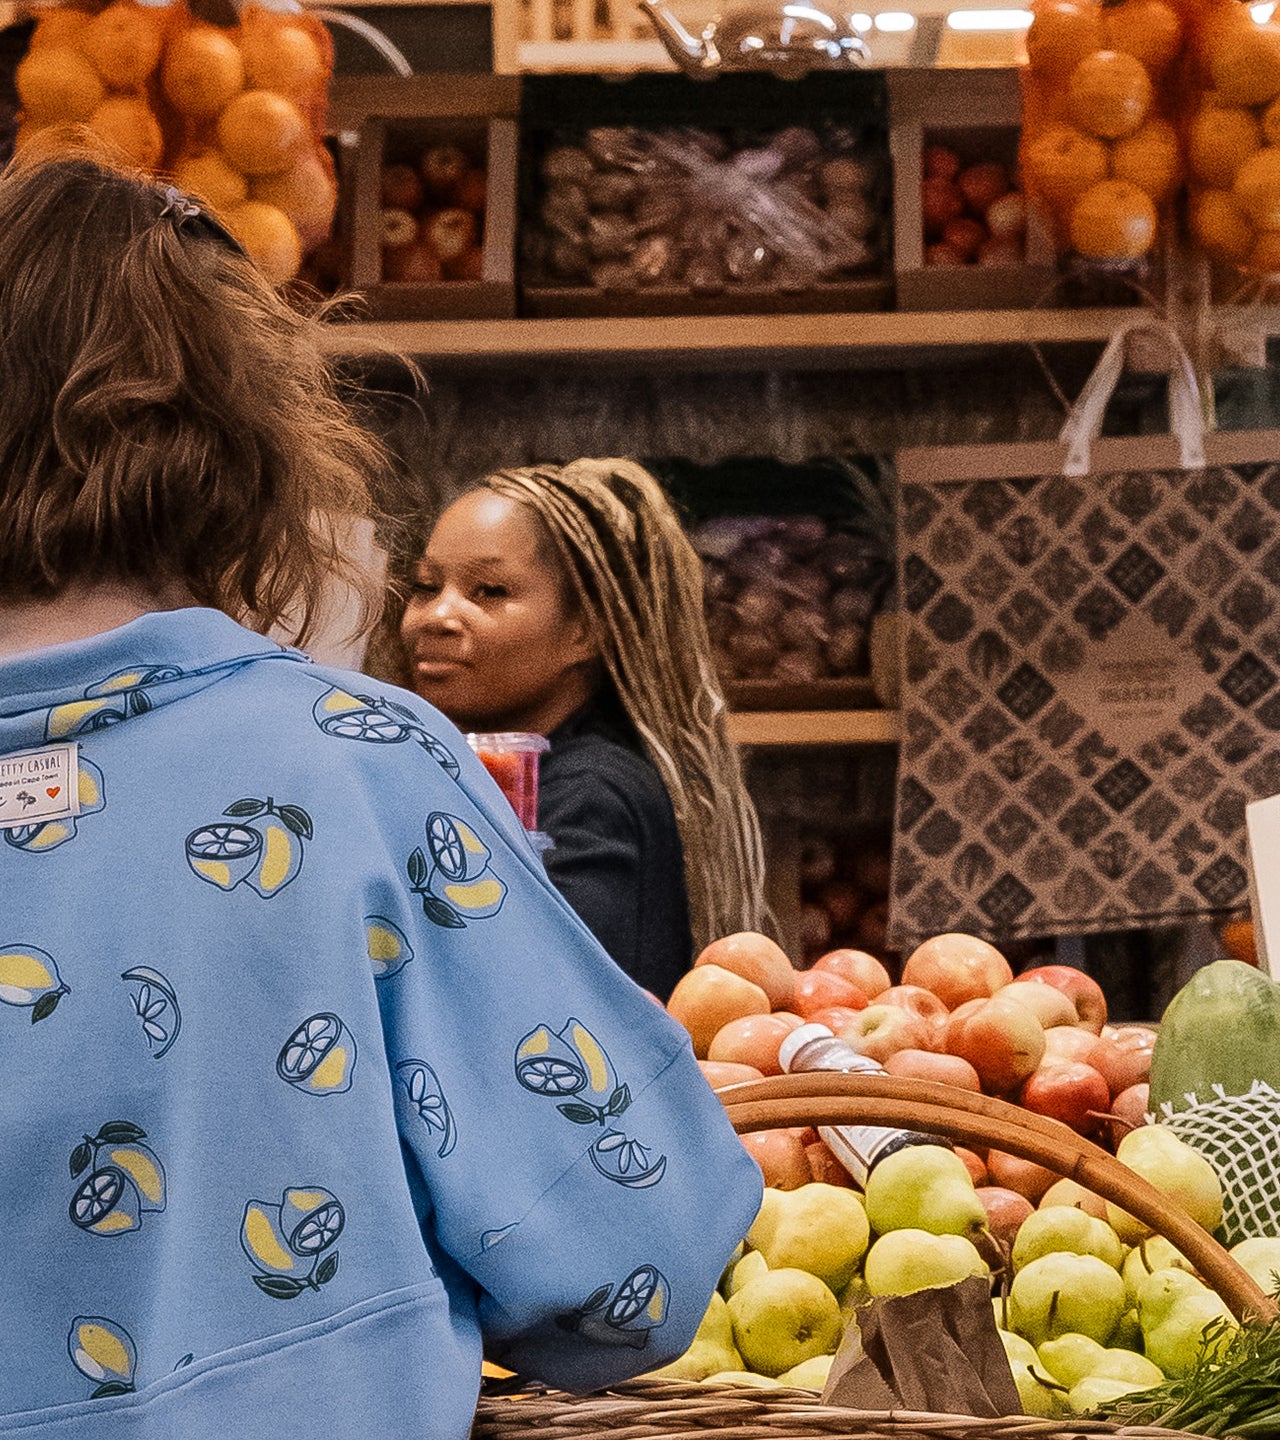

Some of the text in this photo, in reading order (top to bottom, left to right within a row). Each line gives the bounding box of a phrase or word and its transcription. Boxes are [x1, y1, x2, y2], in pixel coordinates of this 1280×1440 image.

[27, 755, 61, 773] CASUAL
[13, 778, 21, 786] in
[21, 777, 40, 785] Cape
[41, 773, 59, 781] Town
